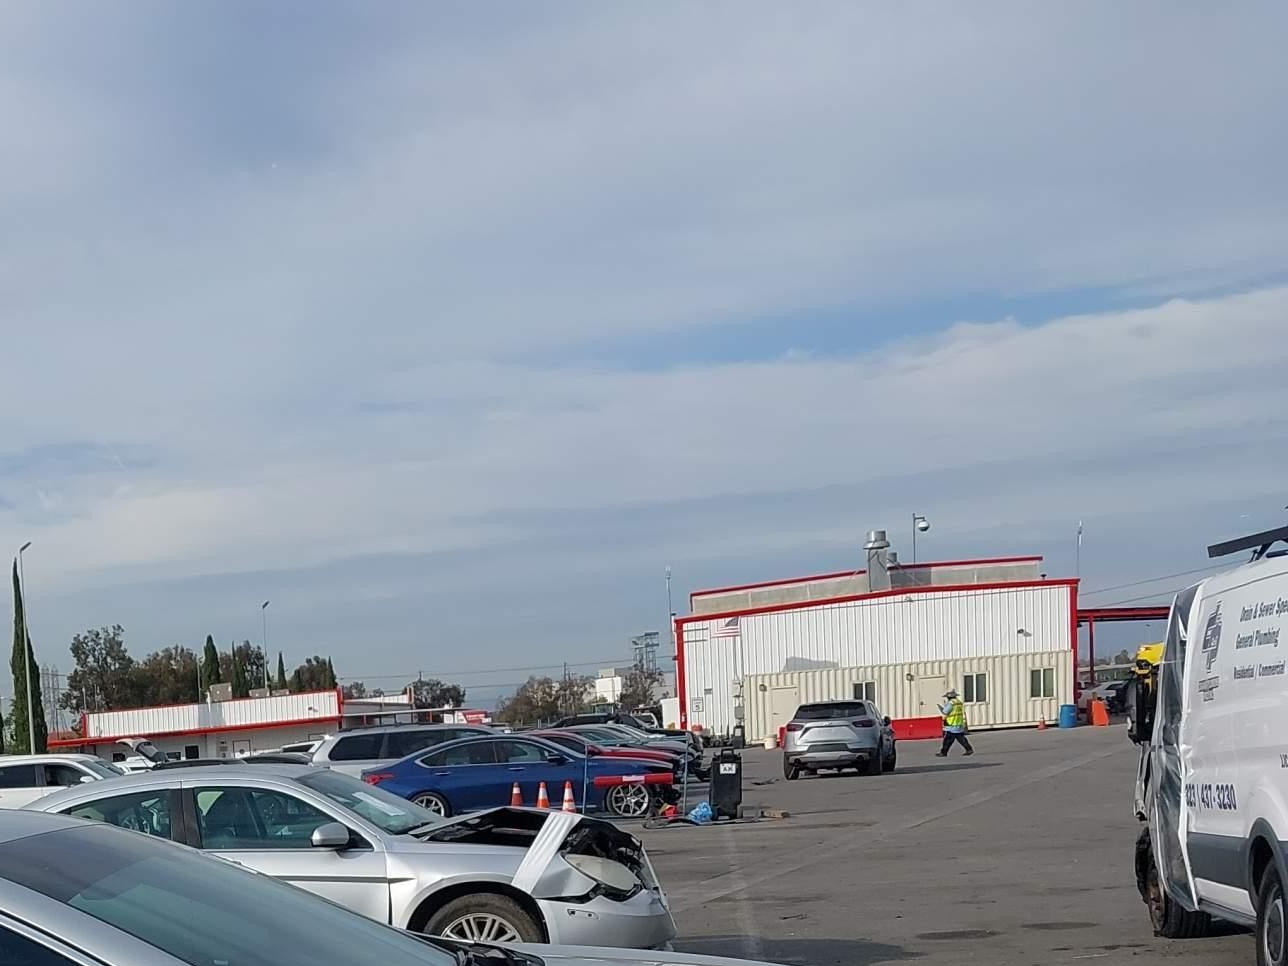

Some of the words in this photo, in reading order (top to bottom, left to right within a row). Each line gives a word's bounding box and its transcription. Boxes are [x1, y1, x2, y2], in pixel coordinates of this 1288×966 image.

[1258, 601, 1276, 618] Sewer
[1235, 631, 1255, 650] General
[1254, 627, 1280, 648] Plumbing
[1233, 664, 1255, 679] Residential
[1258, 660, 1285, 676] Commercial
[1201, 784, 1237, 811] 437-3230
